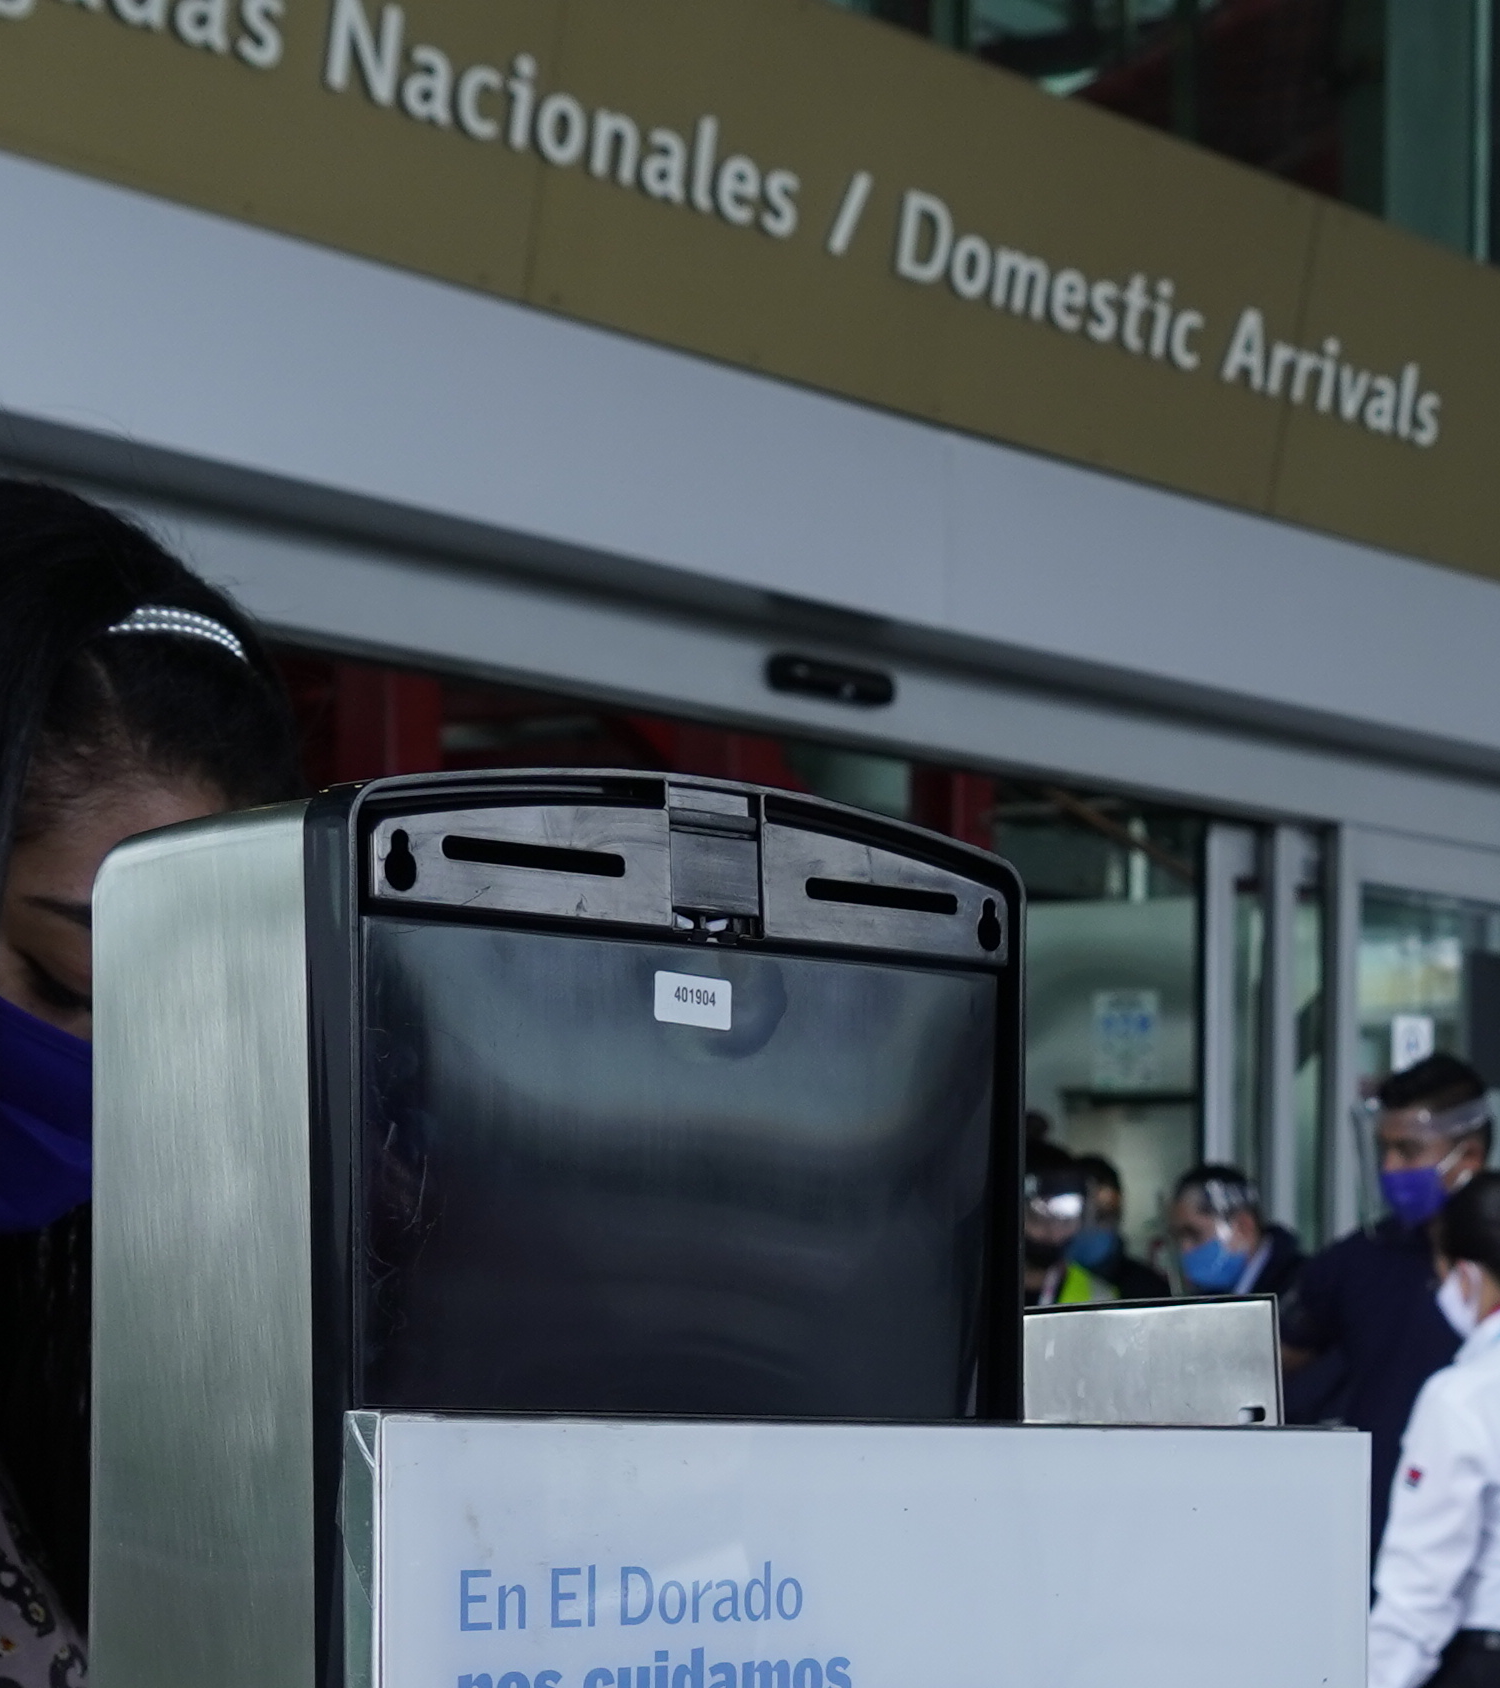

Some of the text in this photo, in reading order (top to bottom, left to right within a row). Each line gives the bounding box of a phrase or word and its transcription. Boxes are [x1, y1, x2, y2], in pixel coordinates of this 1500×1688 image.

[322, 0, 799, 237] Nacionales
[896, 189, 1204, 370] Domestic
[1221, 307, 1441, 447] Arrivals
[674, 985, 717, 1007] 401904
[458, 1560, 804, 1633] En El Dorado
